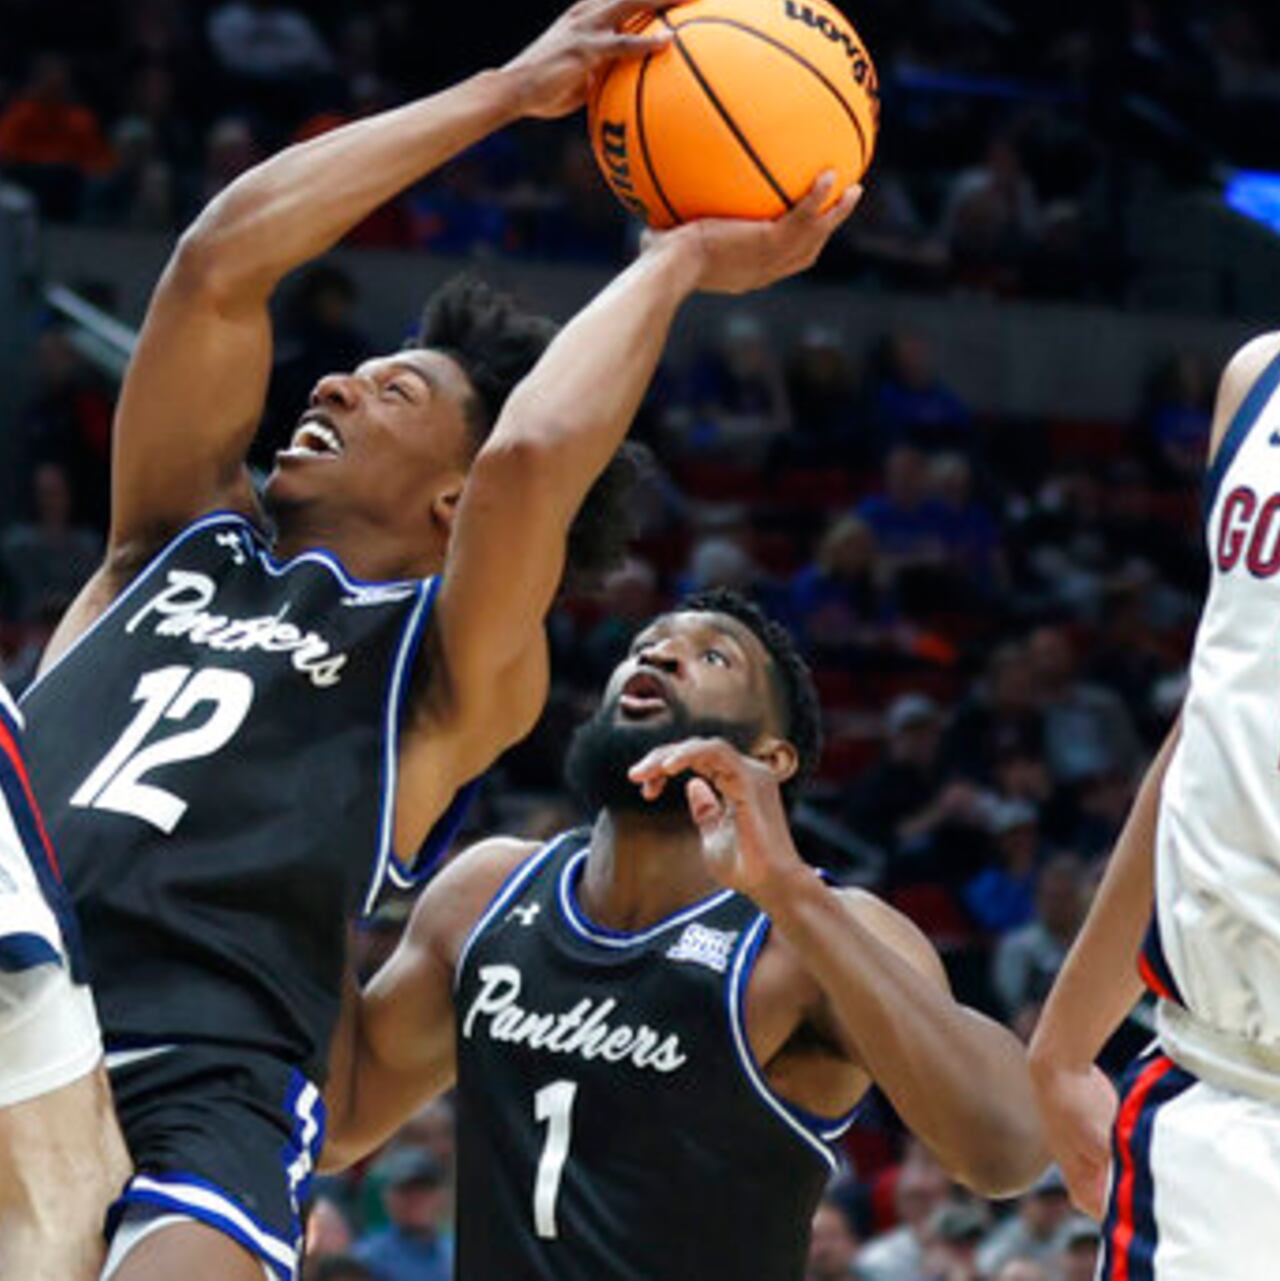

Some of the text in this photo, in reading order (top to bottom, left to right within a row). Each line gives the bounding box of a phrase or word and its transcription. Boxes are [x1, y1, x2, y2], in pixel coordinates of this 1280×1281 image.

[68, 665, 257, 835] 12
[462, 964, 687, 1072] Panthers
[533, 1080, 578, 1239] 1
